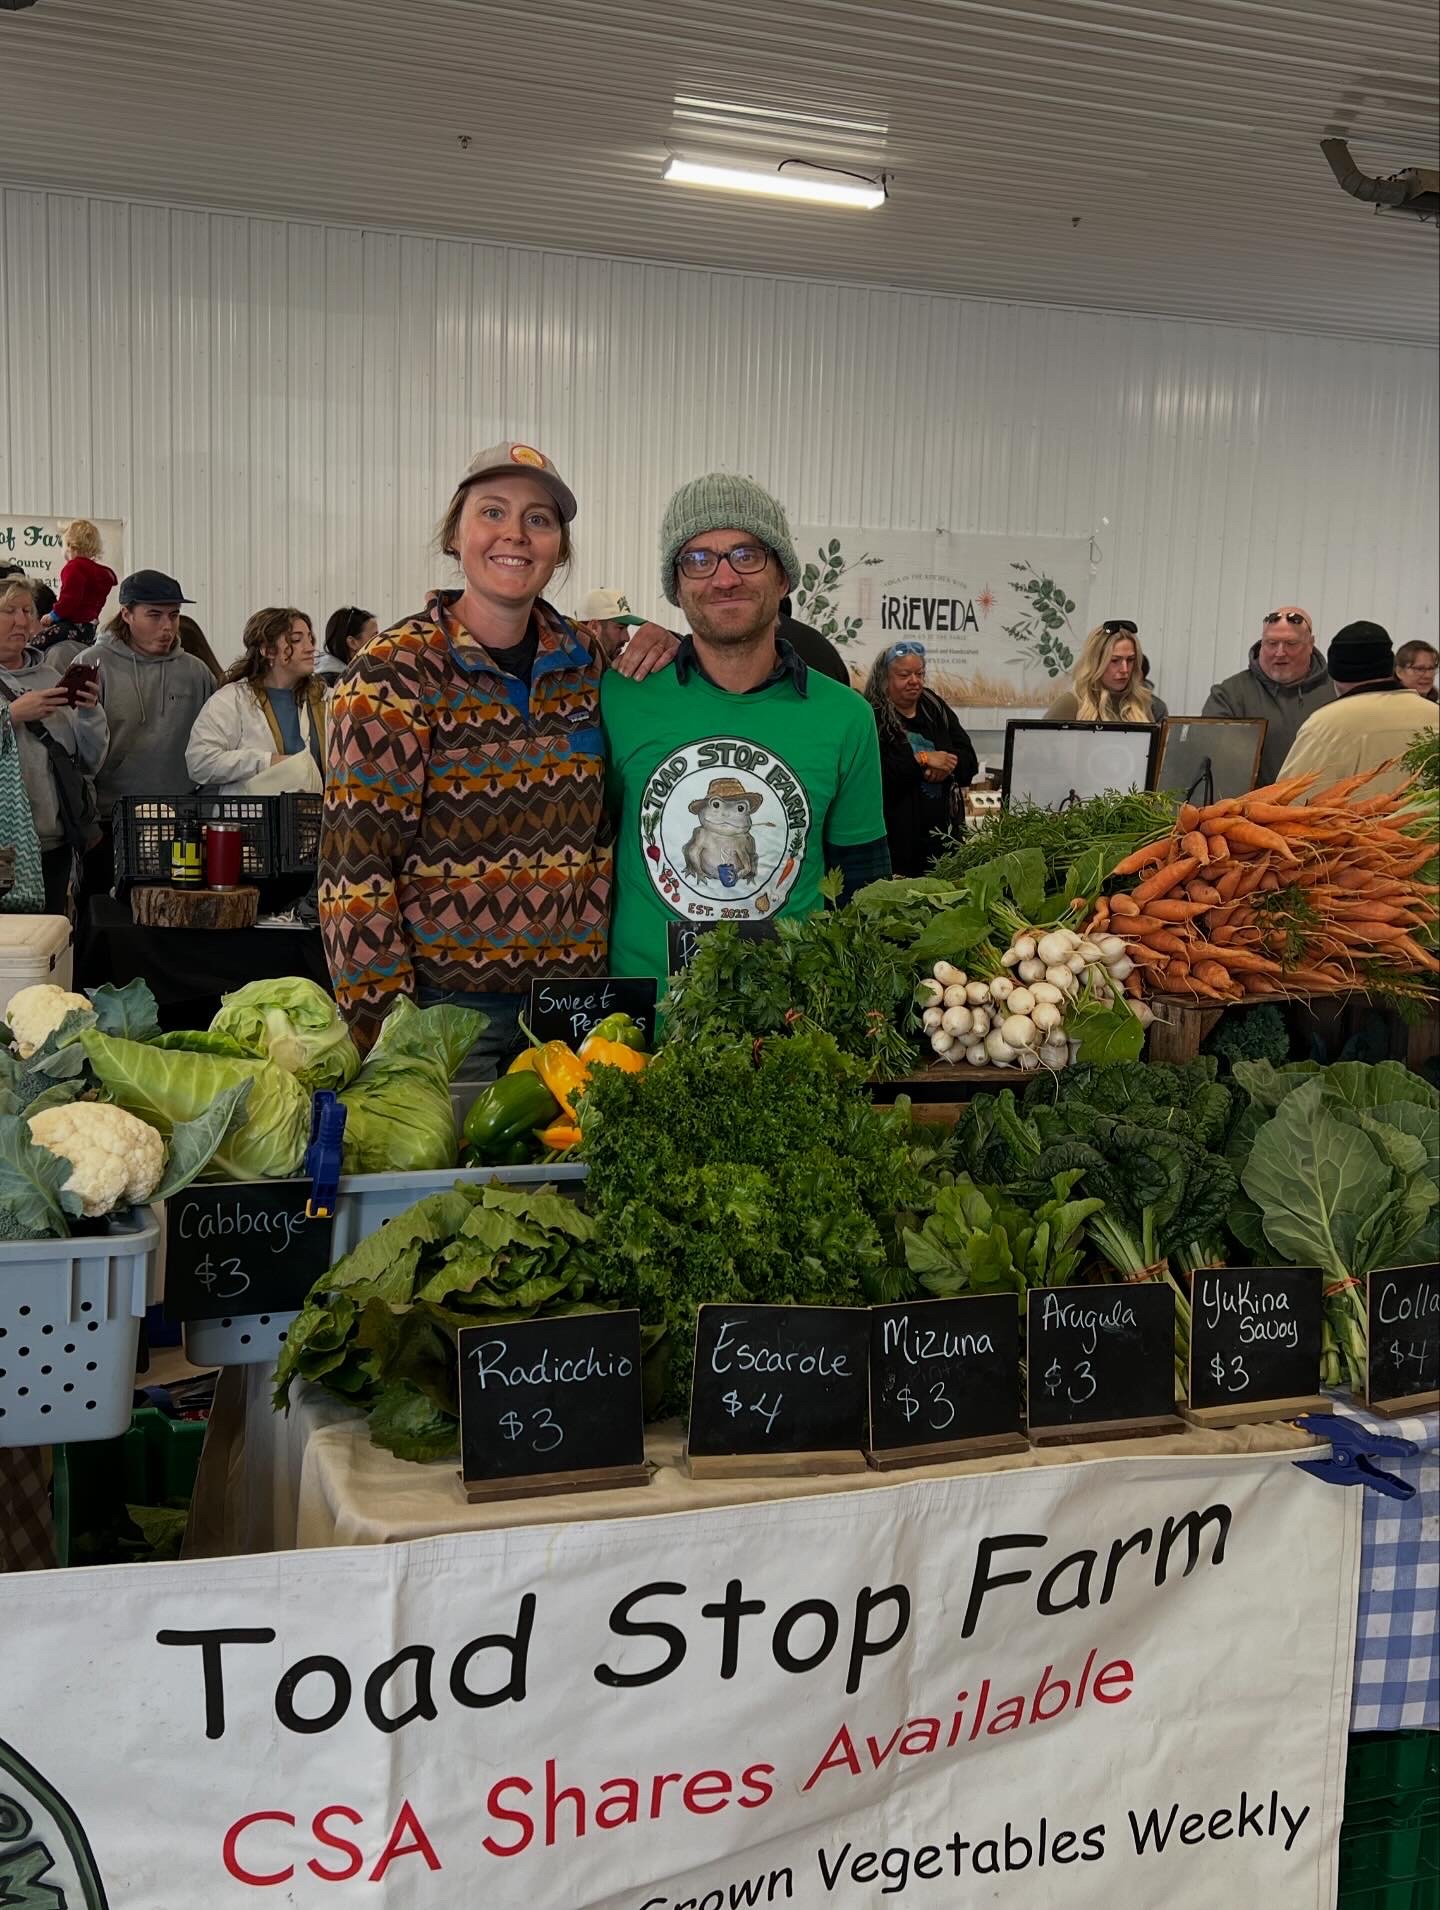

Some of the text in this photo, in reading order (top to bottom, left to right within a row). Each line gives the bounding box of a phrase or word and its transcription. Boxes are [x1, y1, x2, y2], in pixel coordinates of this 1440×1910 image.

[643, 742, 808, 830] TOAD STOP FARM
[688, 902, 714, 917] EST.
[538, 983, 617, 1014] Sweet
[179, 1202, 308, 1253] Cabbage
[194, 1253, 250, 1298] $3
[883, 1315, 995, 1365] Mizuna
[1042, 1291, 1137, 1354] Arugula
[468, 1339, 633, 1390] Radicchio
[711, 1320, 853, 1377] Escarole
[1210, 1351, 1251, 1392] $3
[1389, 1338, 1430, 1376] $4
[1044, 1357, 1097, 1404] $3
[498, 1407, 564, 1452] $3
[721, 1389, 784, 1434] $4
[896, 1381, 956, 1430] $3
[156, 1503, 1233, 1740] Toad Stop Farm
[222, 1647, 1135, 1886] CSA Shares Available
[816, 1818, 1106, 1894] Vegetables
[1128, 1789, 1310, 1851] Weekly
